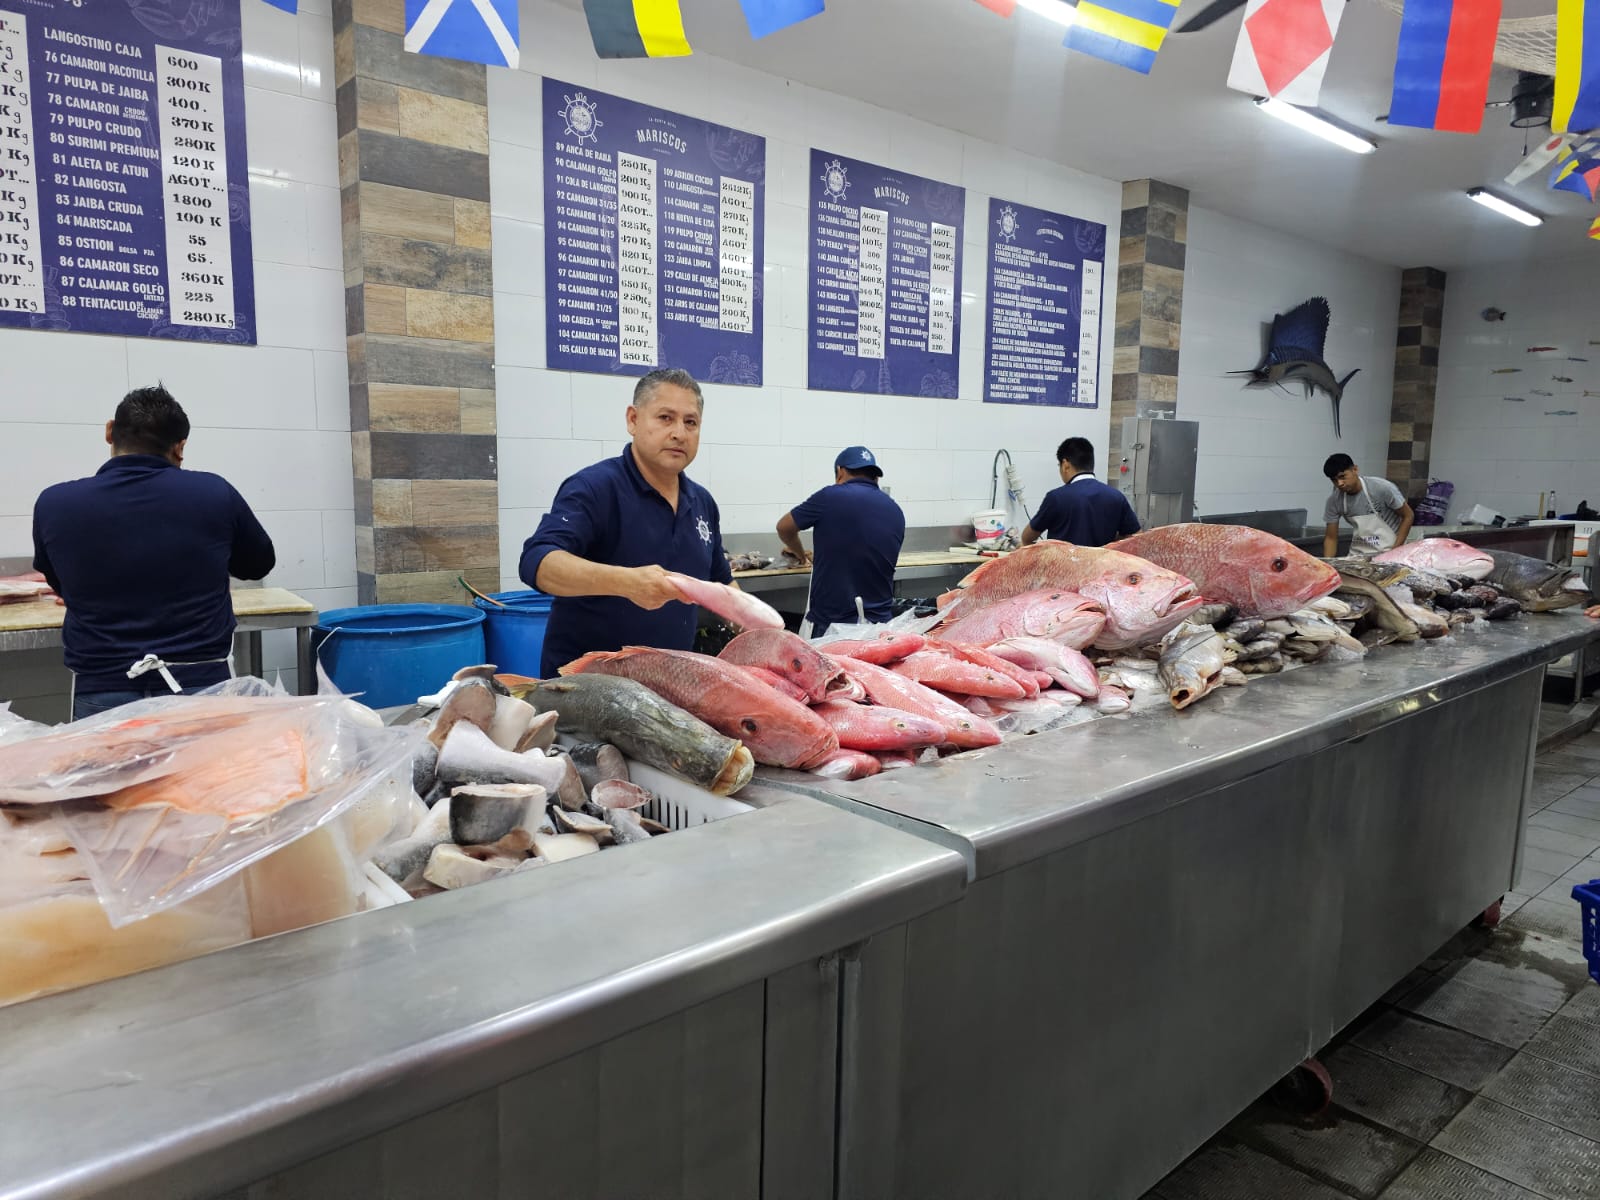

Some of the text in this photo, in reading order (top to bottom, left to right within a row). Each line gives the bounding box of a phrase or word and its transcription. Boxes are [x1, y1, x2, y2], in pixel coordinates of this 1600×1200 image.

[44, 27, 142, 58] LANGOSTINO CAJA
[45, 51, 155, 83] 76 CAMARON PACOTILLA
[168, 56, 198, 70] 600
[46, 72, 149, 102] 77 PULPA DE JAIBA
[48, 93, 62, 105] 78
[65, 96, 120, 116] CAMARON
[50, 113, 142, 138] 79 PULPO CRUDO
[50, 132, 159, 160] 80 SURIMI PREMIUM
[636, 129, 687, 153] MARISCOS
[556, 142, 612, 163] 89 ANCA DE RANA
[53, 153, 149, 178] 81 ALETA DE ATUN
[555, 157, 617, 178] 90 CALAMAR GOLFO
[54, 173, 127, 194] 82 LANGOSTA
[556, 174, 617, 194] 91 COLA DE LANGOSTA
[663, 180, 675, 189] 110
[675, 181, 703, 195] LANGOSTA
[173, 193, 212, 208] 1800
[556, 190, 565, 199] 92
[566, 192, 598, 207] CAMARON
[873, 185, 910, 205] MARISCOS
[55, 194, 144, 216] 83 JAIBA CRUDA
[674, 198, 700, 211] CAMARON
[556, 206, 565, 215] 93
[566, 207, 597, 221] CAMARON
[57, 214, 133, 234] 84 MARISCADA
[557, 221, 566, 230] 94
[567, 222, 599, 236] CAMARON
[664, 225, 675, 234] 119
[675, 227, 694, 238] PULPO
[58, 235, 72, 247] 85
[75, 237, 114, 251] OSTION
[189, 234, 207, 246] 55
[557, 236, 566, 246] 95
[567, 238, 599, 251] CAMARON
[664, 240, 675, 249] 120
[675, 241, 703, 254] CAMARON
[60, 256, 159, 276] 86 CAMARON SECO
[558, 252, 567, 262] 96
[568, 254, 599, 267] CAMARON
[558, 268, 566, 277] 97
[567, 269, 598, 282] CAMARON
[674, 270, 691, 281] CALLO
[691, 273, 699, 283] DE
[61, 276, 164, 295] 87 CALAMAR GOLFO
[557, 283, 566, 292] 98
[567, 284, 599, 296] CAMARON
[675, 285, 703, 297] CAMARON
[62, 296, 137, 311] 88 TENTACULO
[184, 291, 214, 303] 225
[558, 298, 566, 307] 99
[567, 299, 595, 311] CAMARON
[688, 301, 695, 310] DE
[695, 302, 719, 313] CALAMAR
[559, 314, 594, 326] 100 CABEZA
[688, 314, 695, 323] DE
[559, 329, 570, 338] 104
[571, 330, 600, 341] CAMARON
[559, 344, 617, 357] 105 CALLO DE HACHA
